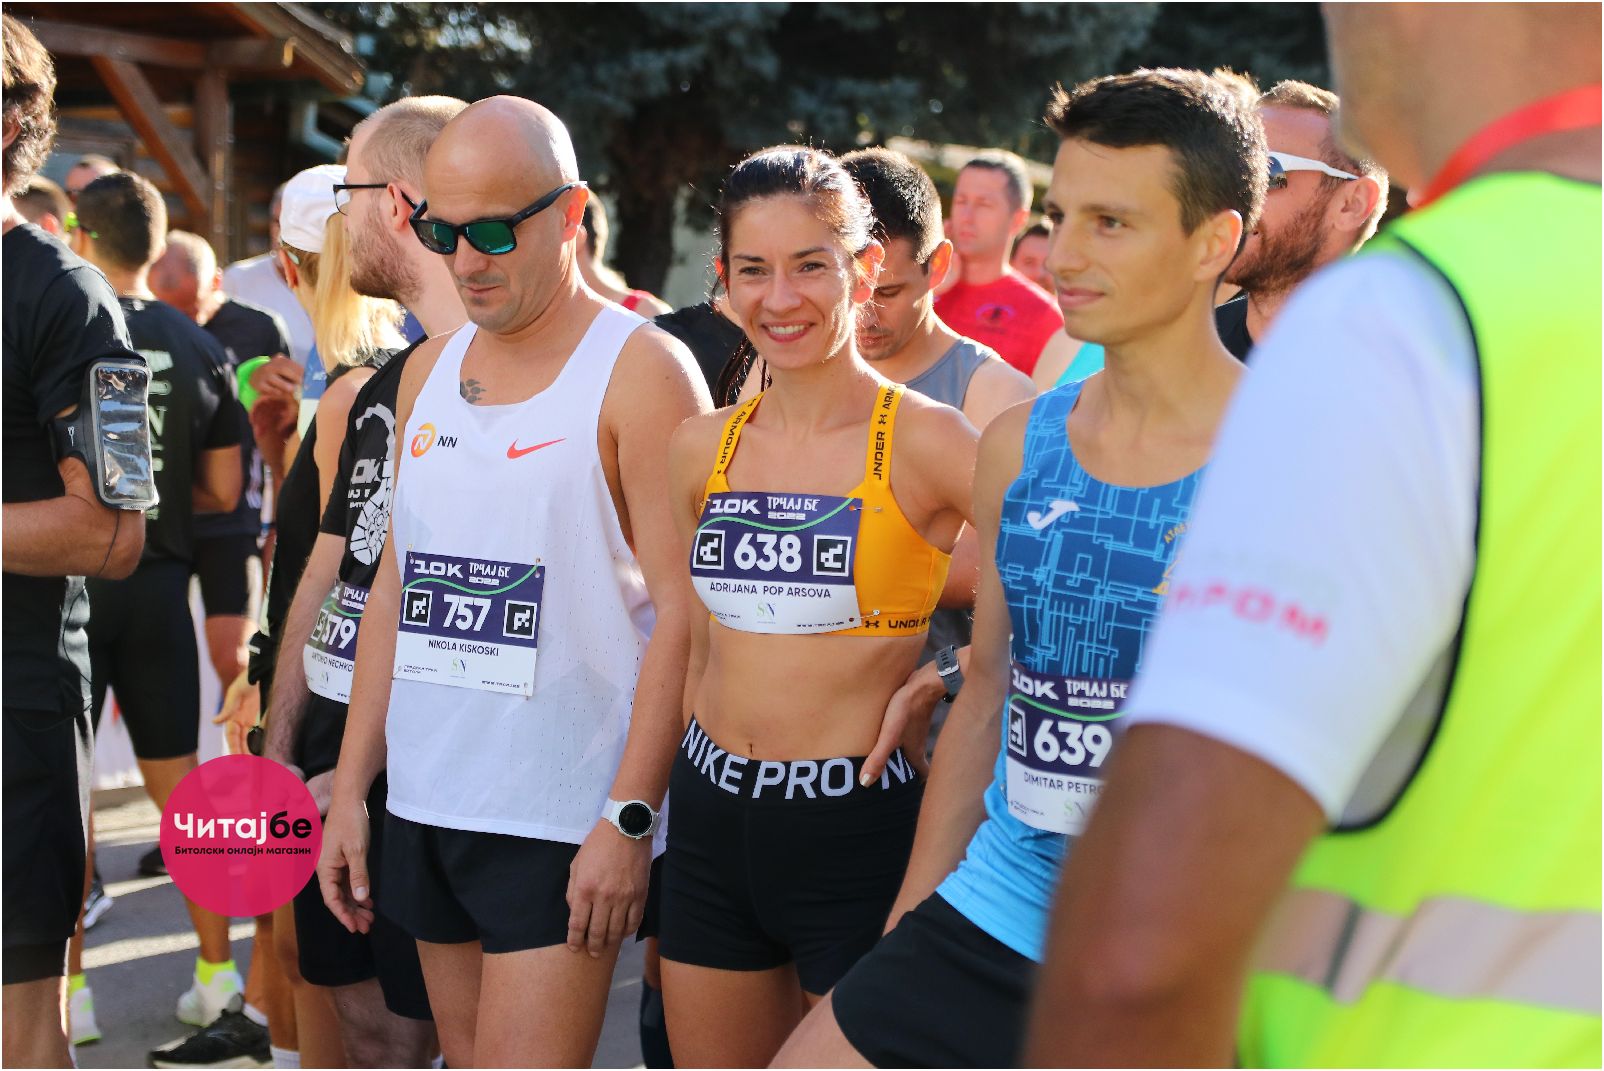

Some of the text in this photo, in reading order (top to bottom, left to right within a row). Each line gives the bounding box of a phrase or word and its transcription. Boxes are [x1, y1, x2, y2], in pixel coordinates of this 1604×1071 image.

[437, 435, 458, 448] NN
[720, 411, 747, 465] ARMOUR
[709, 498, 761, 515] 10K
[766, 496, 801, 511] ТРЧАЈ
[767, 511, 806, 520] 2022
[733, 532, 802, 573] 638
[413, 559, 464, 579] 10K
[469, 561, 497, 576] ТРЧАЈ
[709, 581, 832, 599] ADRIJANA POP ARSOVA
[443, 593, 492, 632] 757
[428, 639, 499, 657] NIKOLA KISKOSKI
[1012, 668, 1059, 701] 10K
[1065, 679, 1108, 698] ТРЧАЈ
[1033, 719, 1113, 768] 639
[681, 719, 749, 795] NIKE
[751, 757, 854, 800] PRO
[1023, 771, 1064, 791] DIMITAR
